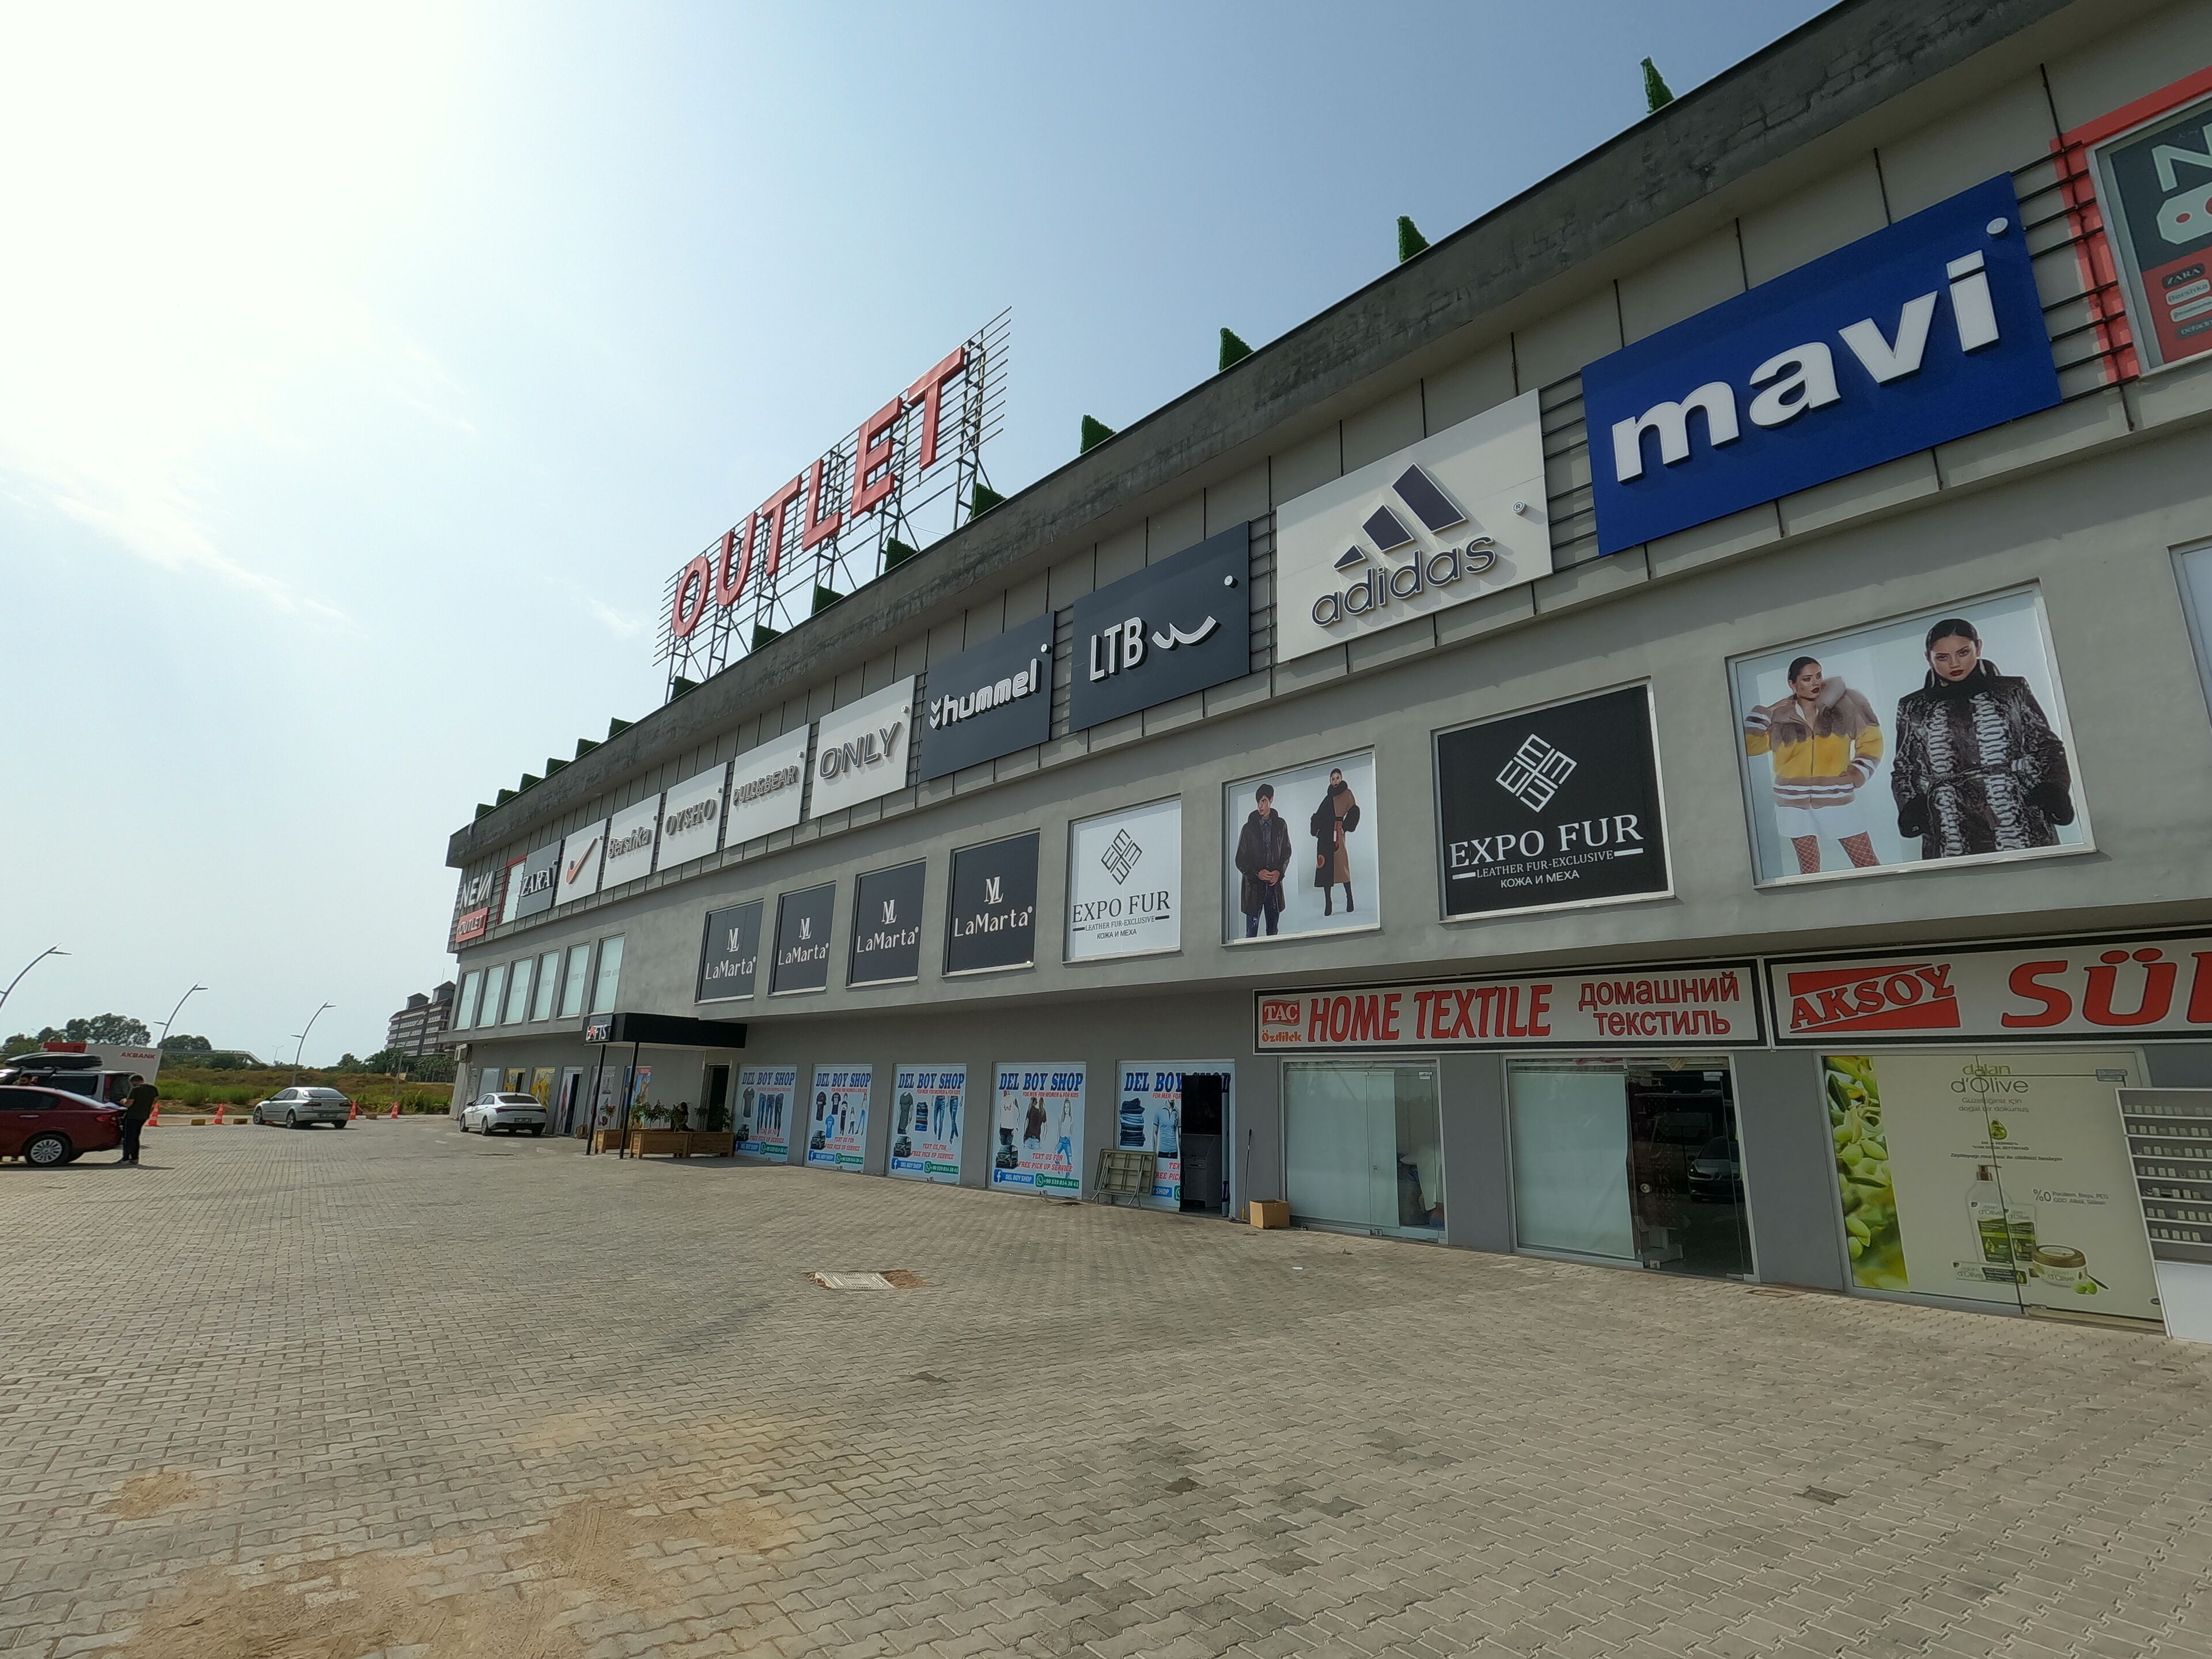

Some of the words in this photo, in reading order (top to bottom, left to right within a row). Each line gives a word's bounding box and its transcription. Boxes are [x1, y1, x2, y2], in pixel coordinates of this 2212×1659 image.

[1612, 249, 1999, 484] mavi
[672, 346, 966, 638] OUTLET
[1310, 536, 1497, 627] adidas
[1090, 616, 1147, 682] LTB
[942, 658, 1042, 726] hummel
[819, 720, 902, 780] ONLY
[733, 764, 800, 806] PULL&BEAR
[664, 797, 716, 836] OYSHO
[607, 826, 653, 859] Bershka
[1449, 830, 1545, 868] EXPO
[1558, 813, 1644, 853] FUR
[1476, 863, 1524, 878] LEATHER
[1527, 850, 1613, 871] FUR-EXCLUSIVE
[521, 866, 554, 897] ZARA
[1501, 876, 1533, 888] КОЖА
[1535, 875, 1543, 885] И
[1546, 869, 1580, 883] МЕХА
[1072, 898, 1122, 923] EXPO
[1128, 890, 1171, 915] FUR
[457, 914, 485, 935] OUTLET
[1085, 922, 1110, 931] LEATHER
[1111, 915, 1156, 928] FUR-EXCLUSIVE
[1096, 931, 1113, 940] КОЖА
[1120, 928, 1137, 937] МЕХА
[1789, 963, 1955, 1030] AKSOY
[1264, 1004, 1298, 1024] TAÇ
[1308, 993, 1402, 1043] HOME
[1413, 984, 1553, 1039] TEXTILE
[1593, 1009, 1731, 1037] текстиль
[1262, 1029, 1302, 1043] Özdilek
[119, 1051, 156, 1059] AKBANK
[742, 1072, 755, 1085] DEL
[756, 1071, 774, 1085] BOY
[774, 1071, 795, 1086] SHOP
[816, 1073, 830, 1087] DEL
[831, 1073, 849, 1088] BOY
[849, 1072, 871, 1088] SHOP
[898, 1073, 914, 1088] DEL
[917, 1073, 937, 1088] BOY
[938, 1073, 965, 1089] SHOP
[999, 1073, 1019, 1090] DEL
[1022, 1073, 1048, 1090] BOY
[1050, 1072, 1083, 1091] SHOP
[1124, 1072, 1150, 1092] DEL
[1963, 1064, 2011, 1075] dalan
[1051, 1164, 1073, 1172] SERVICE
